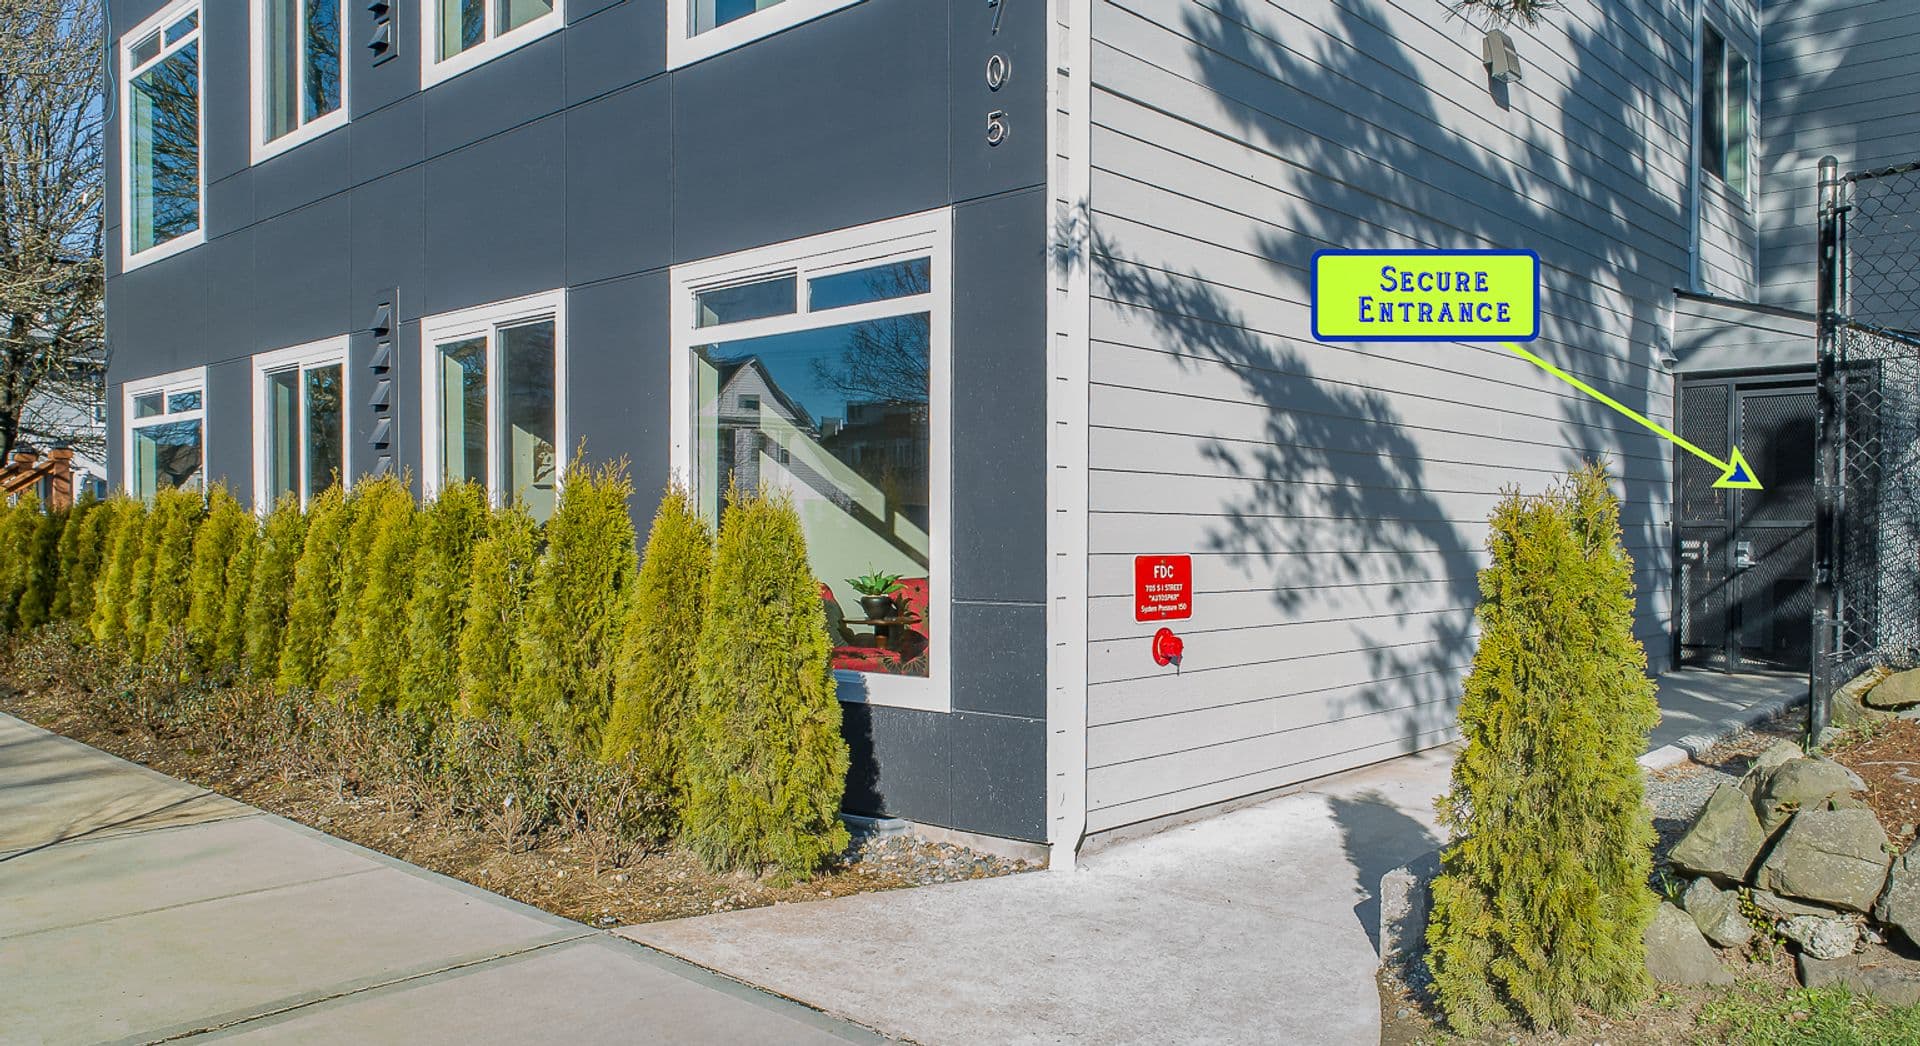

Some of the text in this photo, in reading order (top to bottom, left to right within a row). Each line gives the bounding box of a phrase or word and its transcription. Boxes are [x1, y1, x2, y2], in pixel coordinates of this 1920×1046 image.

[1153, 565, 1174, 579] FDC
[1145, 584, 1155, 592] 705
[1141, 605, 1157, 613] System
[1178, 602, 1187, 610] 150
